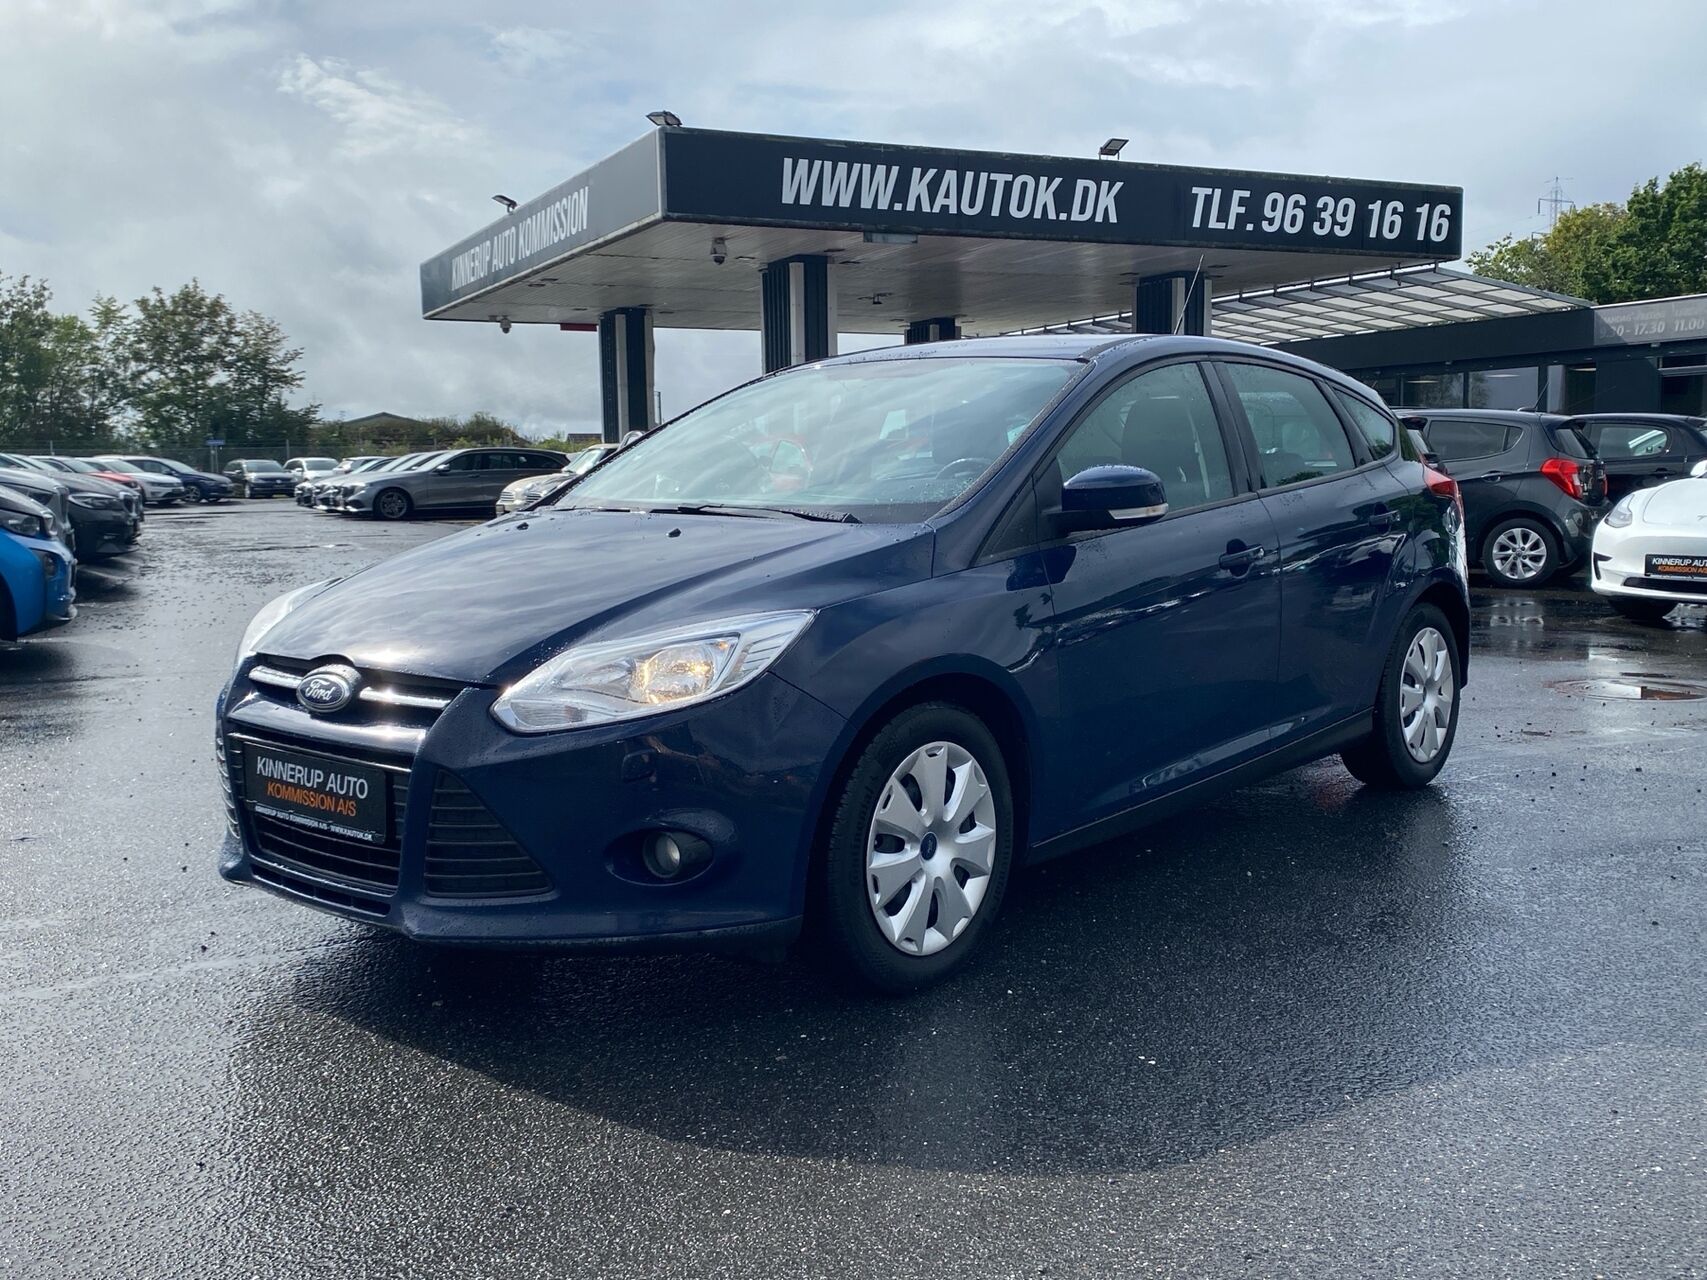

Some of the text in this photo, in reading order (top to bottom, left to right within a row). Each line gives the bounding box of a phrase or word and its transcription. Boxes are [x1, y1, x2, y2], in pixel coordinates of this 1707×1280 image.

[781, 157, 1124, 223] WWW.KAUTOK.DK
[1191, 186, 1451, 242] TLF. 96 39 16 16
[451, 186, 589, 291] KINNERUP AUTO KOMMISSION
[1634, 321, 1666, 335] 17.30
[305, 679, 336, 700] Ford
[256, 756, 369, 799] KINNERUP AUTO
[267, 782, 357, 817] KOMMISSION A/S
